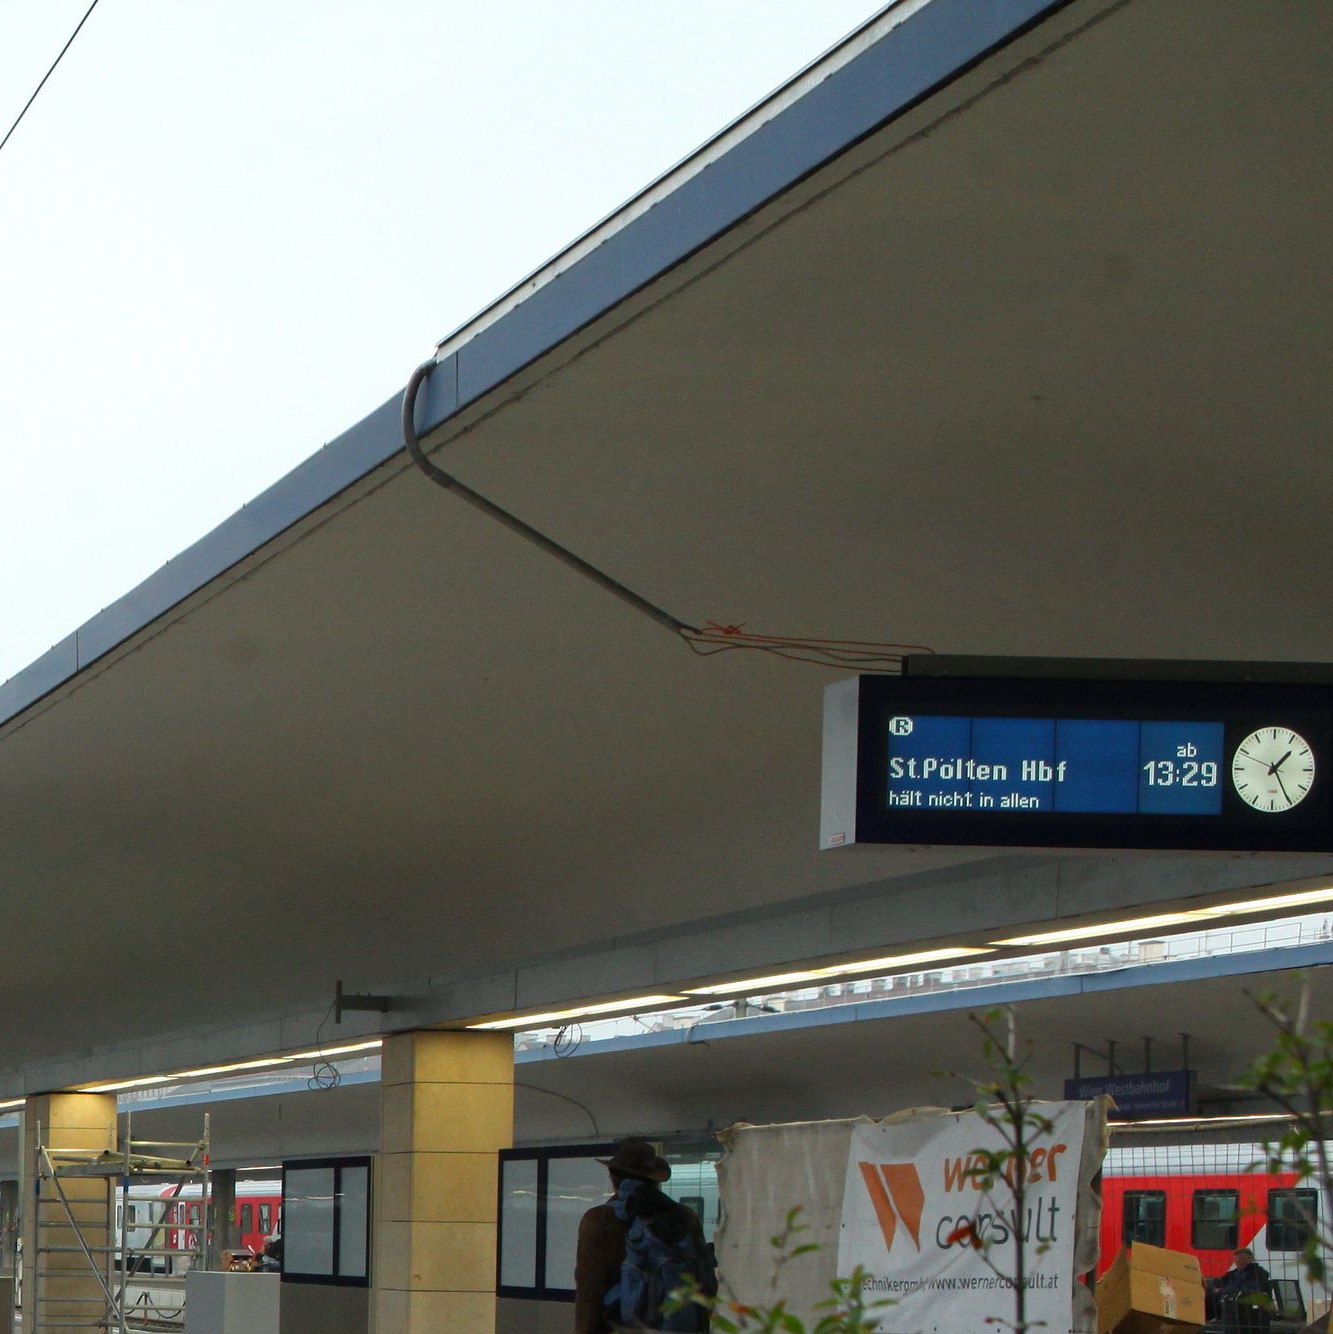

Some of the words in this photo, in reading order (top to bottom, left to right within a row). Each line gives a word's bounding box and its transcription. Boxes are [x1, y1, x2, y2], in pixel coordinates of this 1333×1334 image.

[1176, 742, 1197, 757] ab
[1021, 760, 1067, 782] Hbf
[1143, 760, 1218, 787] 13:29
[889, 790, 922, 806] hält
[928, 791, 973, 807] nicht
[979, 792, 994, 807] in
[1000, 793, 1039, 808] allen
[1105, 1078, 1171, 1097] Westbahnhof
[944, 1143, 1068, 1193] wener
